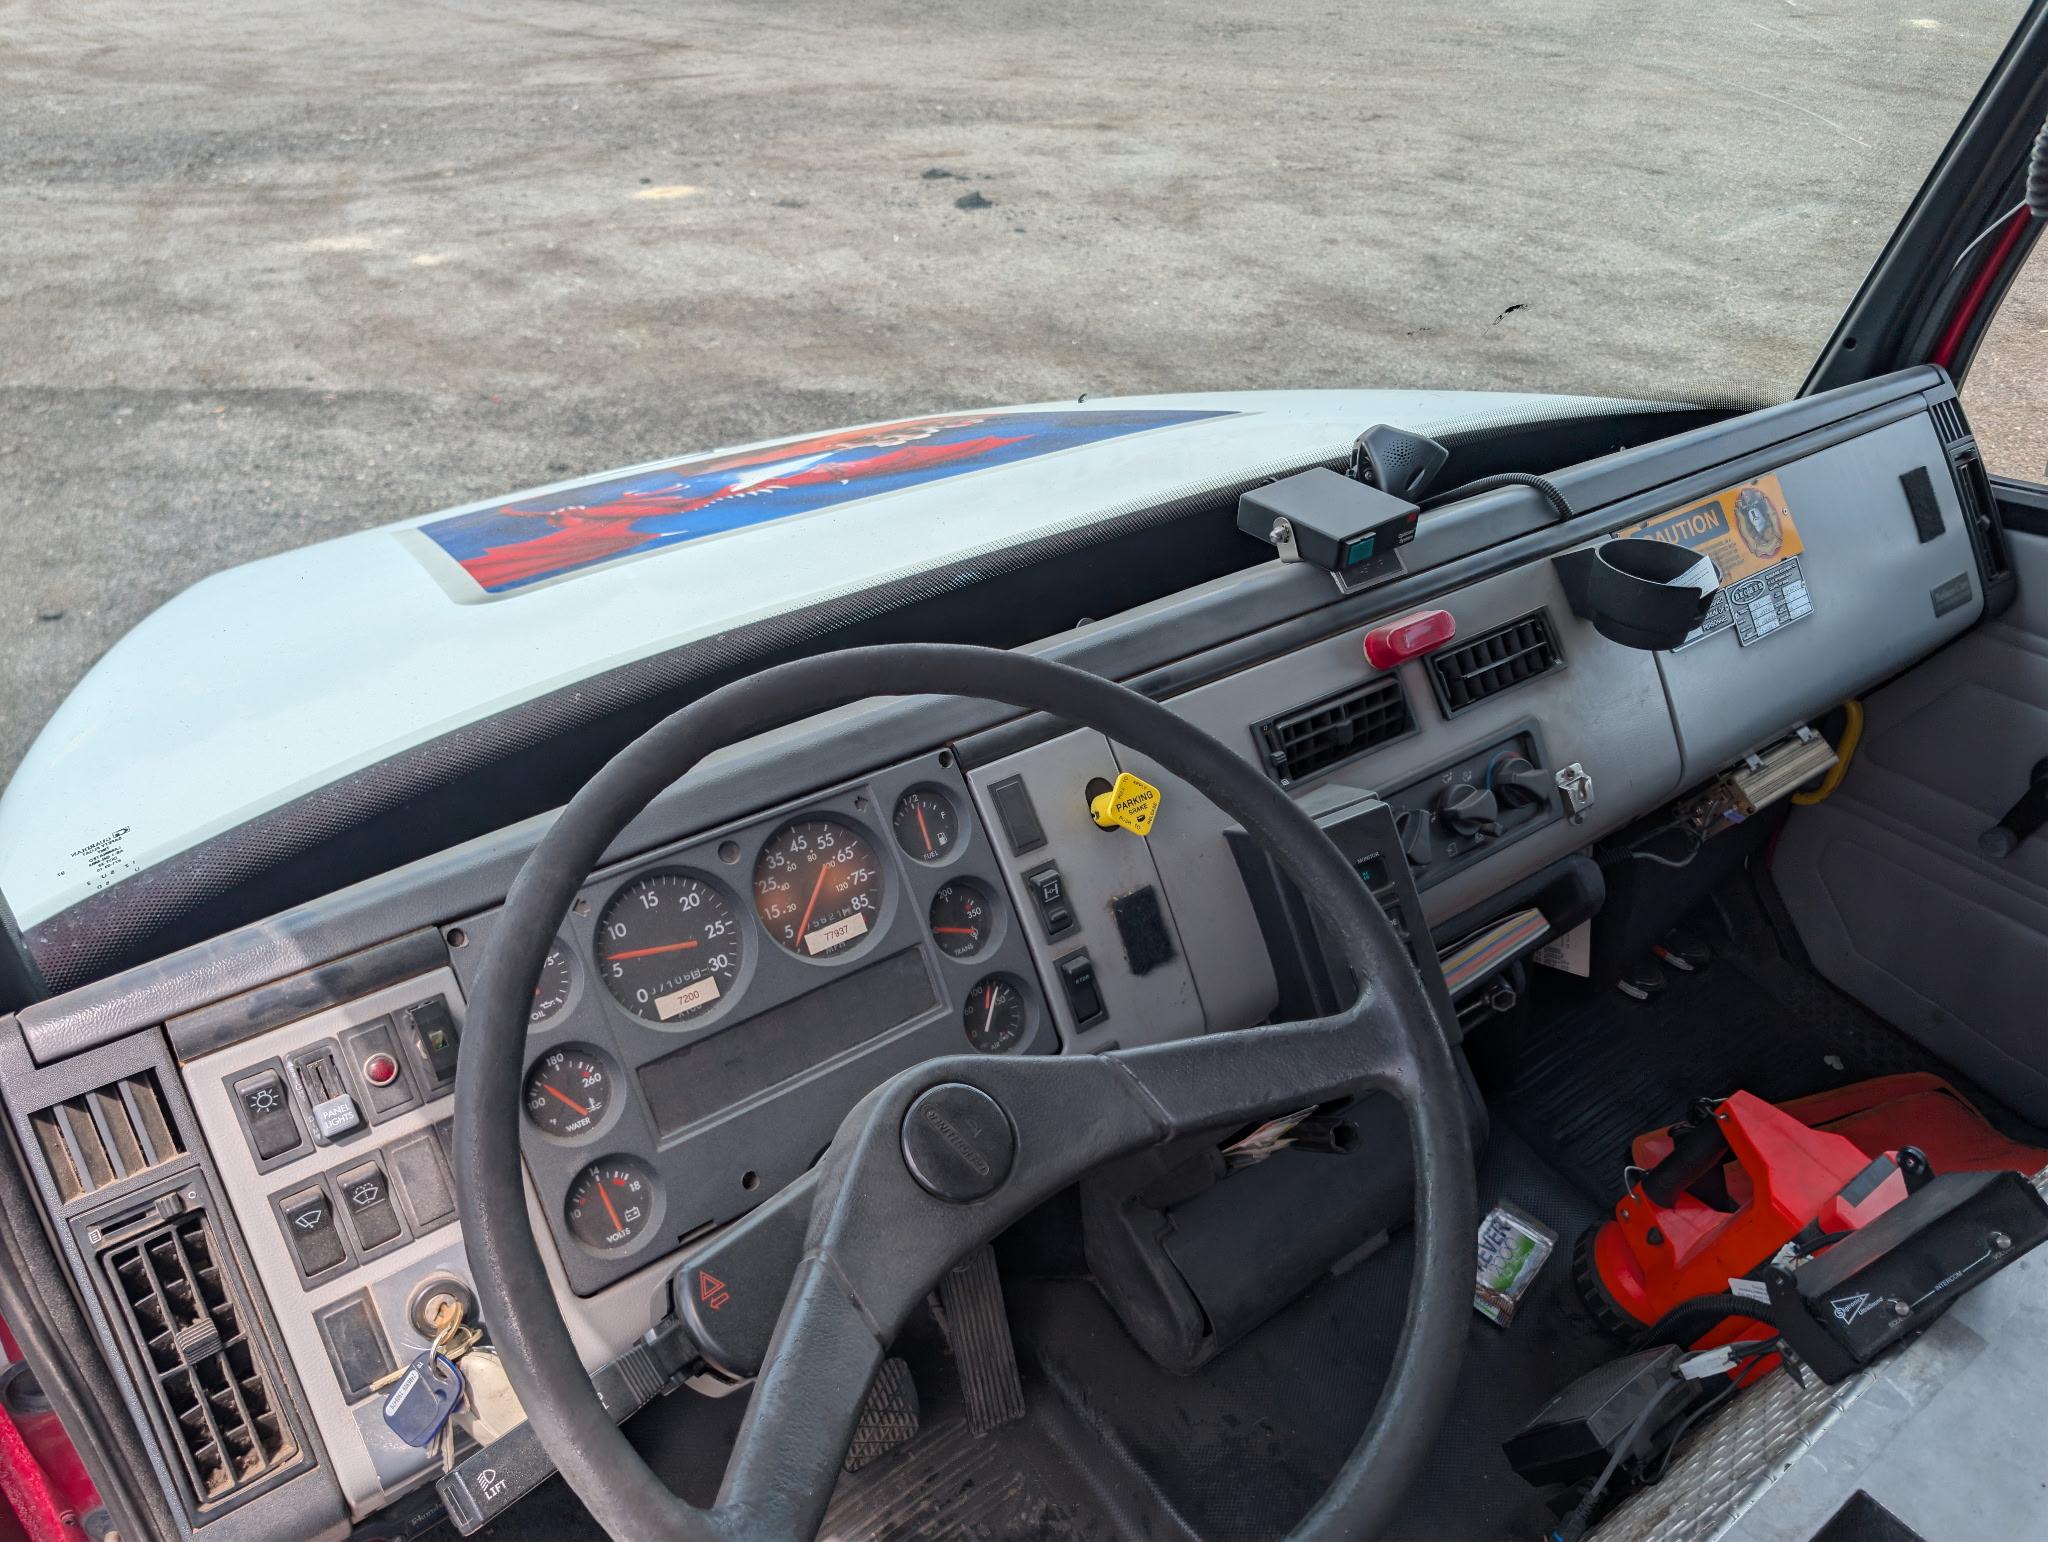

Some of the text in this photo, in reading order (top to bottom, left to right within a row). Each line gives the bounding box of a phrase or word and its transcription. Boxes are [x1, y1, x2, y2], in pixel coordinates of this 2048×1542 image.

[1116, 791, 1154, 812] PARKING
[1129, 804, 1148, 815] BRAKE
[790, 836, 807, 852] 45
[817, 833, 834, 849] 55
[766, 852, 784, 869] 35
[837, 846, 854, 862] 65
[924, 850, 939, 859] FUEL
[786, 863, 796, 872] 60
[851, 869, 867, 885] 75
[759, 877, 776, 894] 25
[836, 882, 848, 892] 120
[640, 891, 659, 909] 15
[679, 893, 700, 911] 20
[851, 894, 868, 910] 85
[765, 905, 780, 920] 15
[786, 903, 796, 913] 20
[966, 906, 981, 918] 350
[608, 923, 627, 940] 10
[704, 920, 725, 939] 25
[785, 925, 793, 938] 5
[824, 925, 848, 942] 77937
[612, 963, 623, 978] 5
[708, 954, 727, 972] 30
[637, 988, 648, 1003] 0
[678, 991, 699, 1005] 7200
[531, 1011, 546, 1020] OIL
[546, 1053, 564, 1066] 180
[582, 1073, 601, 1088] 260
[323, 1103, 350, 1119] PANEL
[528, 1097, 546, 1110] 100
[325, 1112, 354, 1128] LIGHTS
[565, 1117, 591, 1132] WATER
[589, 1166, 600, 1176] 14
[629, 1181, 640, 1192] 18
[606, 1228, 630, 1243] VOLTS
[1935, 1271, 1963, 1291] INTERCOM
[485, 1479, 507, 1500] LIFT
